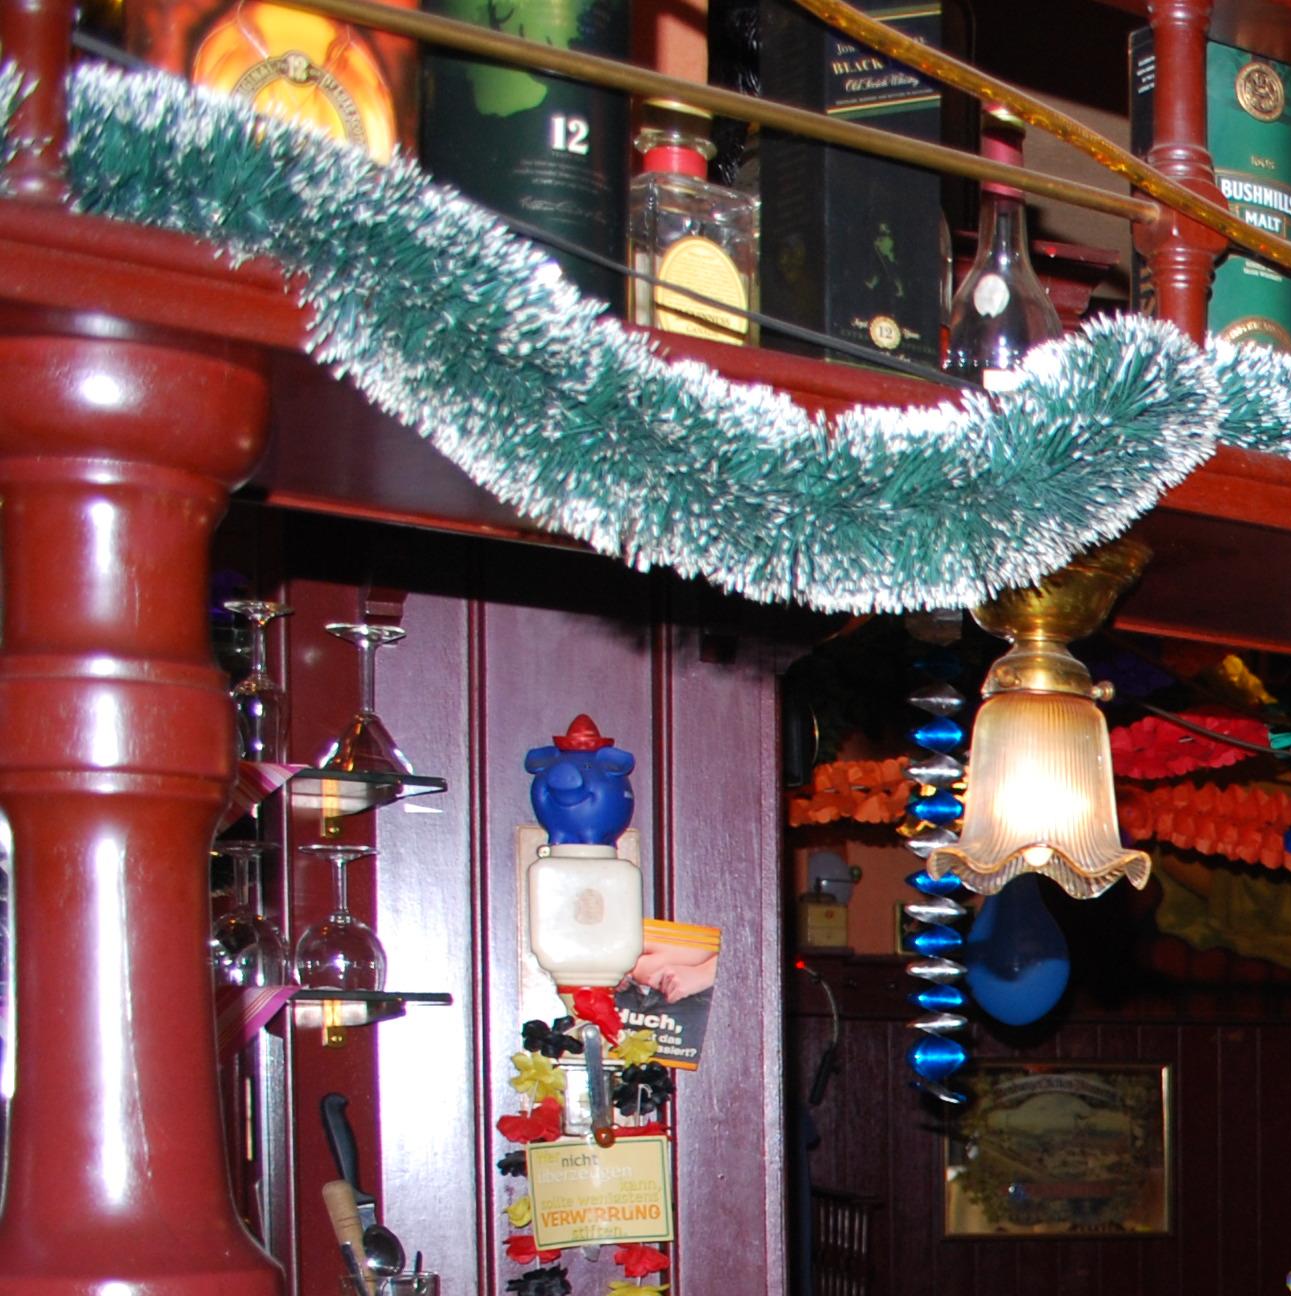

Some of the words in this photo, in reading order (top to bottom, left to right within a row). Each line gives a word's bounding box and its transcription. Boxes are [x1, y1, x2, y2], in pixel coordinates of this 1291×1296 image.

[832, 58, 884, 75] BLACK
[551, 115, 590, 156] 12
[1244, 209, 1282, 233] MALT
[878, 324, 894, 341] 12
[560, 1153, 600, 1168] nicht
